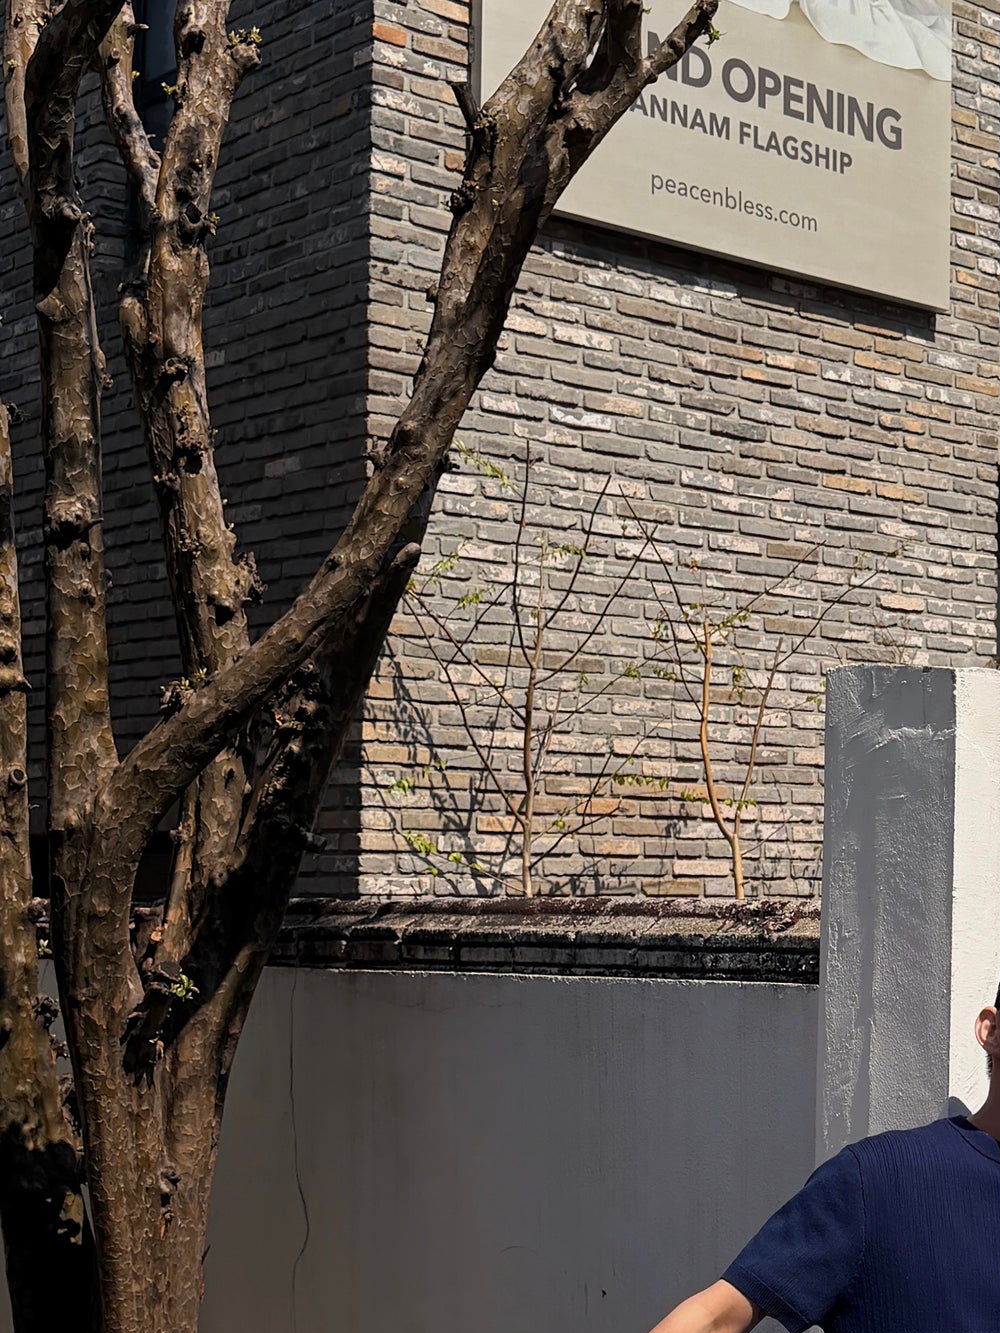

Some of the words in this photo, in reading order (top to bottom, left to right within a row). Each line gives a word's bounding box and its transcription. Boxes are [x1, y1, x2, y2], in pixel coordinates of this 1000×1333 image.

[628, 93, 730, 141] ANNAM
[738, 123, 853, 175] FLAGSHIP
[721, 57, 903, 151] OPENING
[650, 170, 818, 233] peacenbless.com
